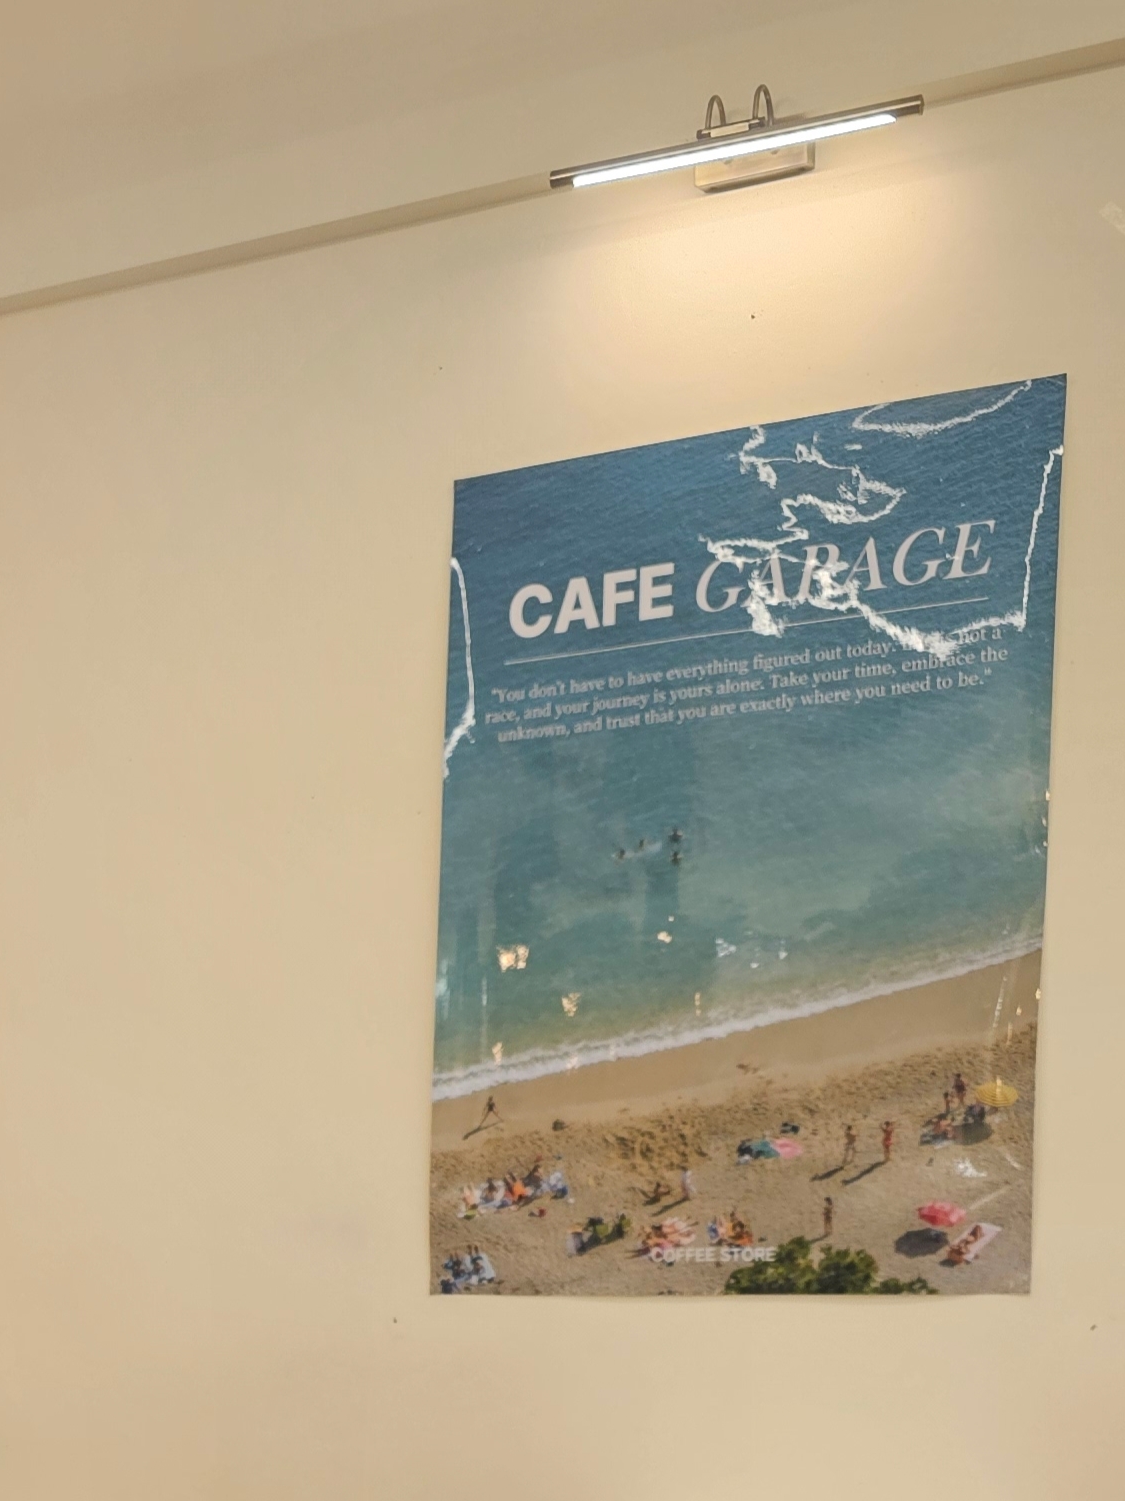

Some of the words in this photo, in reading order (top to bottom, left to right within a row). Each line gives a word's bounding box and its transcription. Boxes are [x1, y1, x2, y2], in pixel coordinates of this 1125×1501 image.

[509, 562, 674, 638] CAFE
[696, 519, 996, 613] GARAGE
[485, 709, 520, 724] race,
[524, 702, 552, 719] and
[555, 701, 590, 719] your
[593, 693, 650, 715] journey
[653, 687, 667, 702] is
[669, 684, 713, 704] yours
[716, 679, 765, 696] alone.
[770, 672, 809, 689] Take
[812, 667, 850, 687] your
[854, 661, 897, 679] time,
[901, 652, 975, 673] embrace
[980, 646, 1009, 663] the
[529, 680, 566, 698] don't
[570, 678, 604, 694] have
[608, 675, 624, 689] to
[627, 671, 662, 687] have
[666, 659, 749, 681] everything
[753, 648, 811, 672] figured
[815, 646, 842, 662] out
[846, 639, 896, 658] today.
[991, 627, 1003, 641] a
[497, 723, 571, 743] unknown,
[574, 716, 603, 734] and
[606, 713, 642, 730] trust
[645, 708, 675, 725] that
[676, 706, 707, 724] you
[710, 702, 737, 716] are
[739, 693, 796, 713] exactly
[800, 689, 852, 707] where
[855, 685, 887, 704] you
[890, 673, 932, 696] need
[935, 674, 953, 690] to
[650, 1246, 717, 1263] COFFEE
[719, 1246, 778, 1263] STORE
